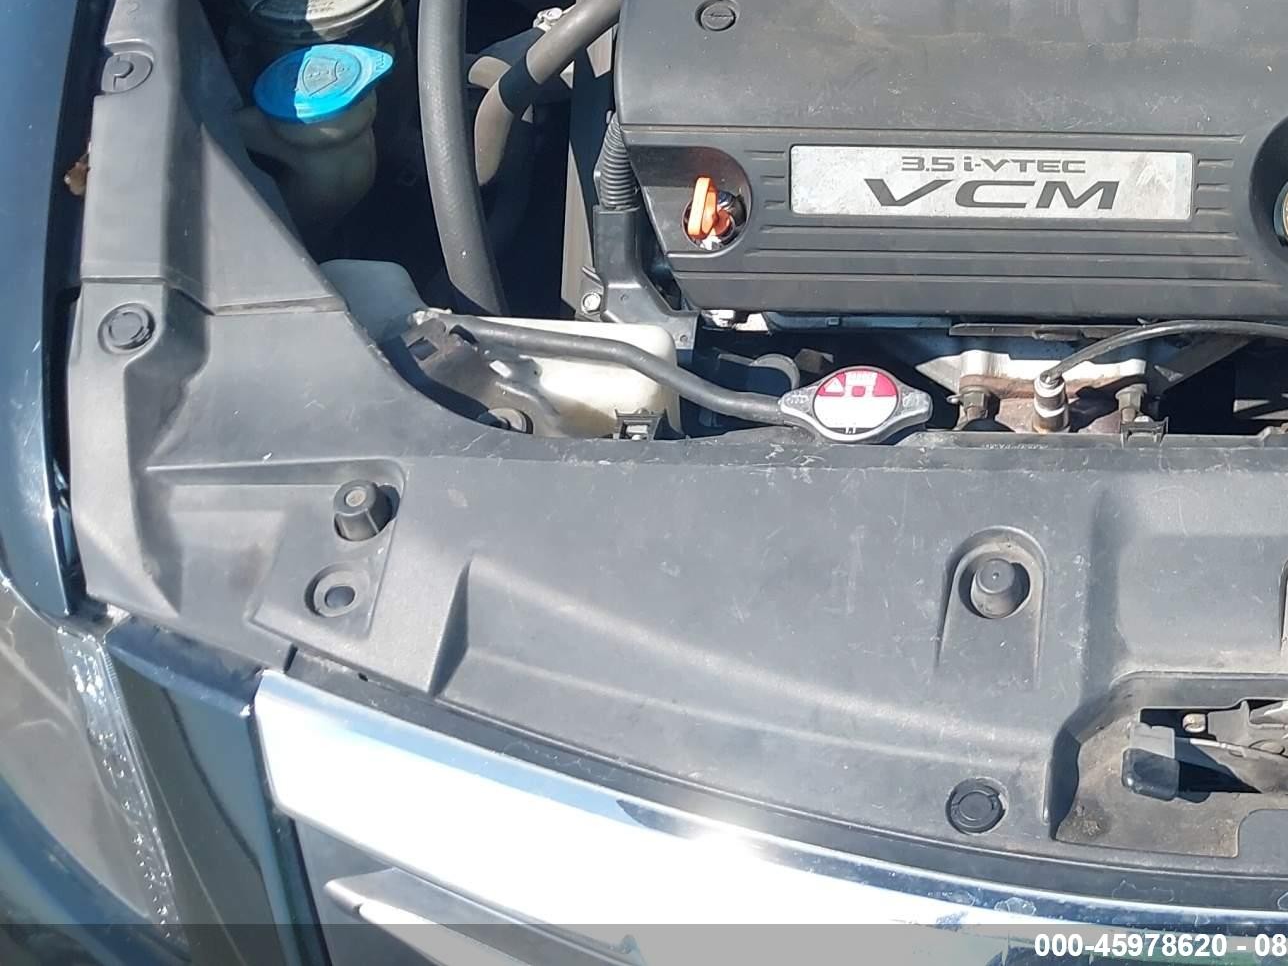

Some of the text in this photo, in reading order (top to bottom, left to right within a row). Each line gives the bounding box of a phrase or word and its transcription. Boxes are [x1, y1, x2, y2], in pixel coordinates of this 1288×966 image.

[901, 155, 1086, 174] 3.5 i-VTEC
[863, 178, 1120, 211] VCM
